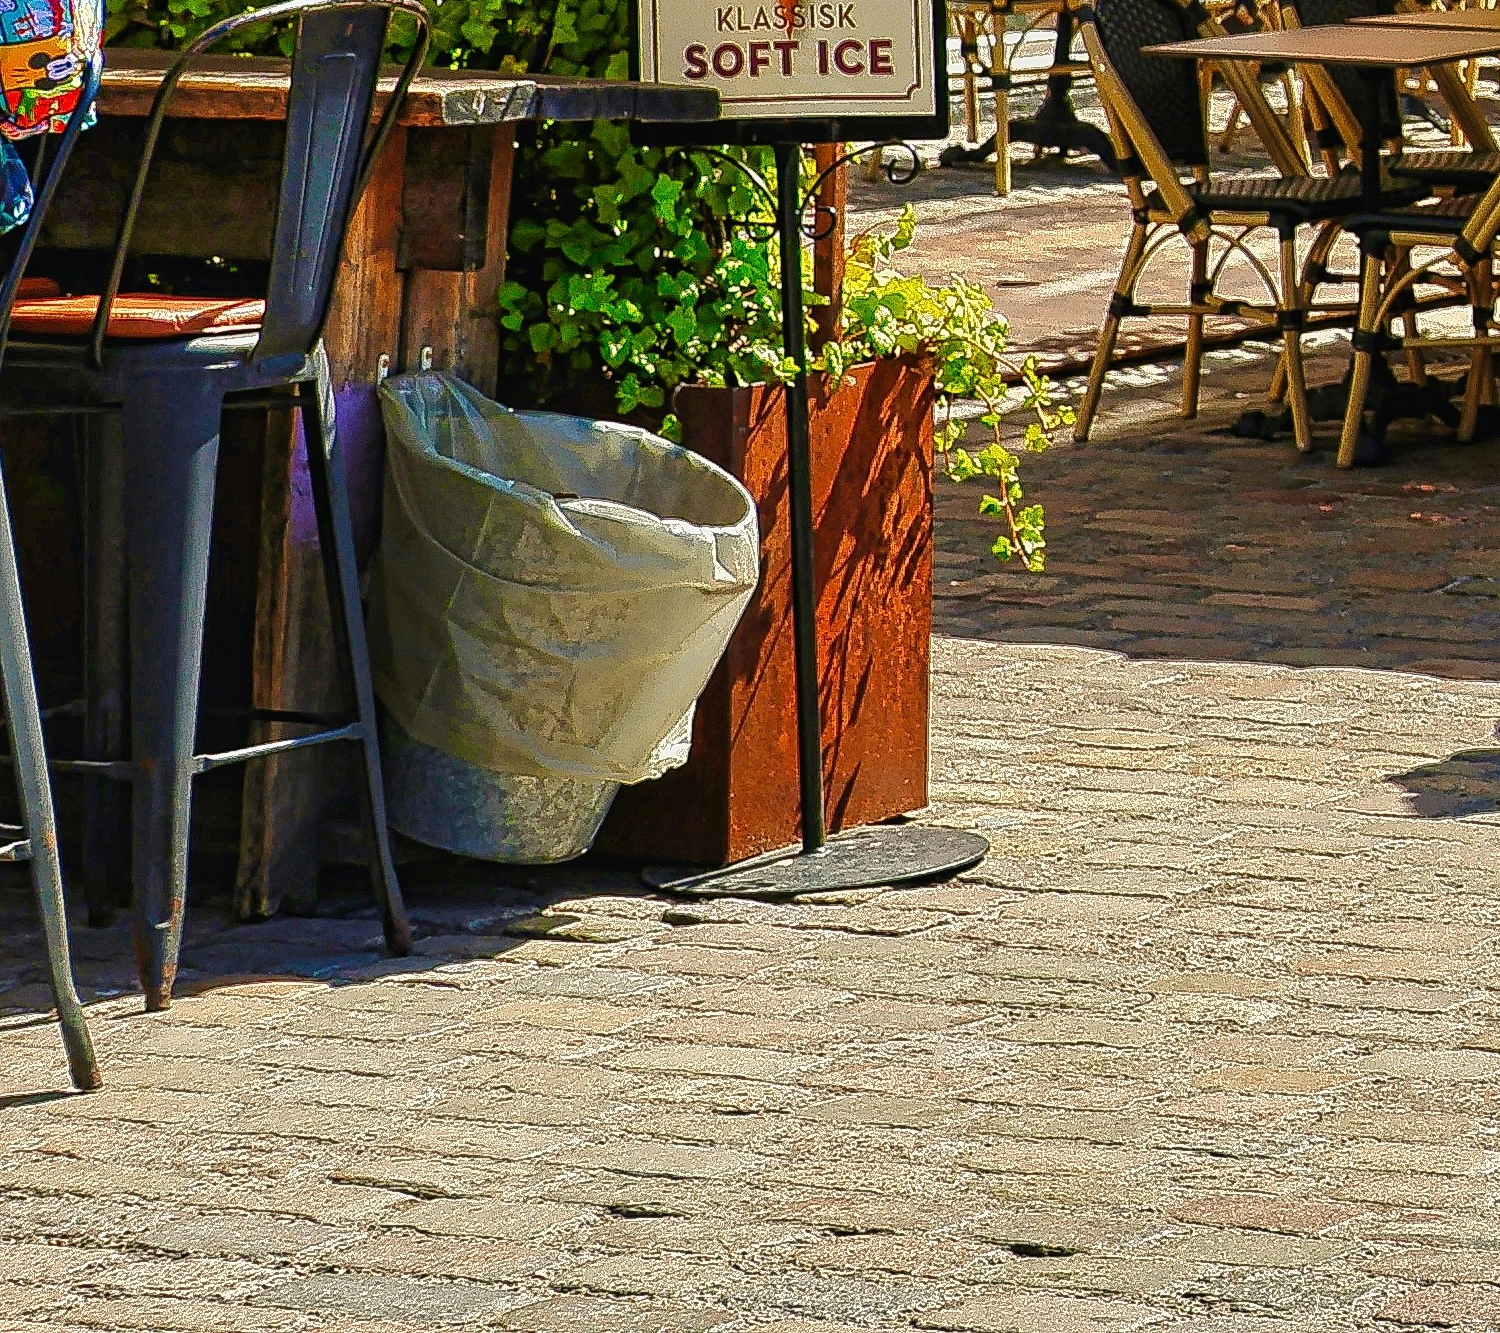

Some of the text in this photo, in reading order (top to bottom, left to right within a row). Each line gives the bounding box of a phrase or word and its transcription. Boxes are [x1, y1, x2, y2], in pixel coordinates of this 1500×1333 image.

[717, 3, 856, 32] KLASSISK
[683, 39, 894, 80] SOFT ICE
